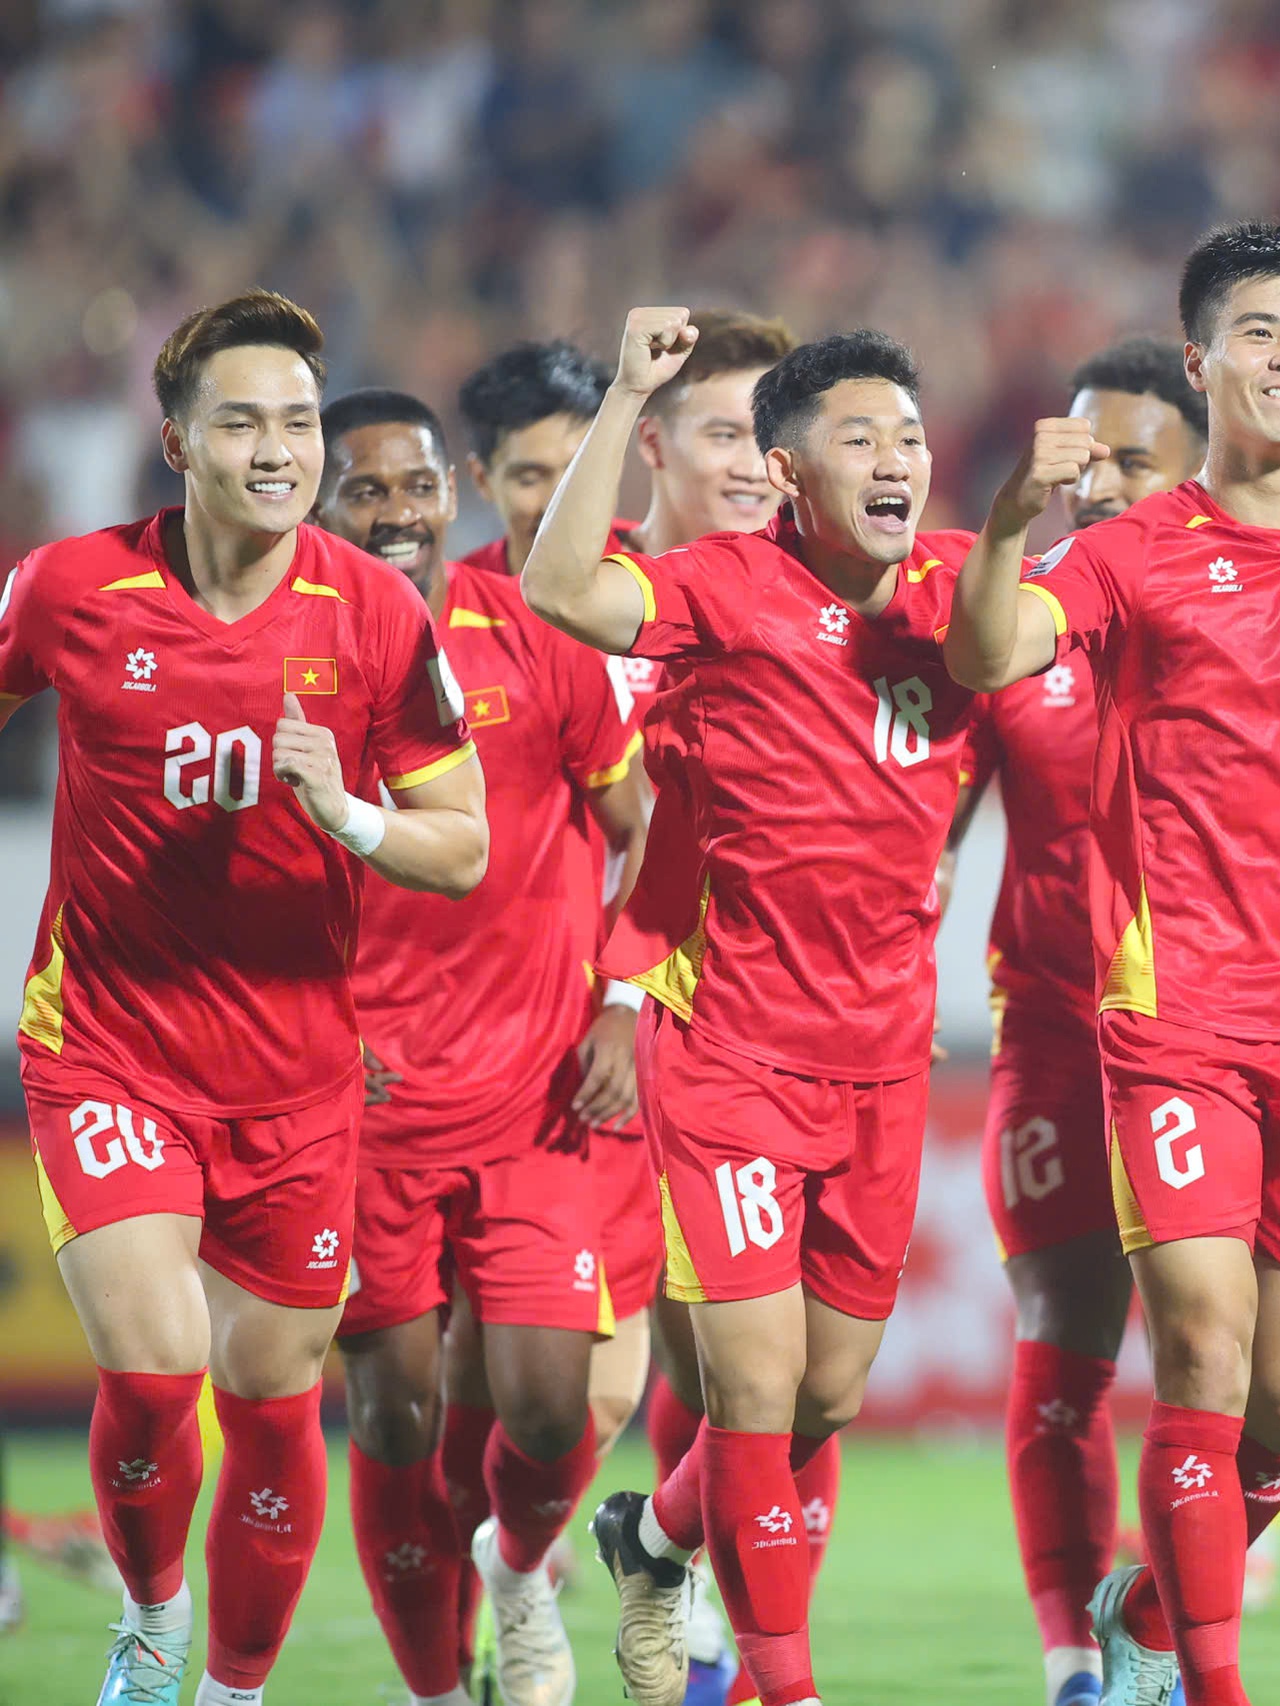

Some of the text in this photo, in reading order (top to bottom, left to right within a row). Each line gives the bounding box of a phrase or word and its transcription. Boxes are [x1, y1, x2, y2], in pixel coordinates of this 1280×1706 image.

[164, 721, 262, 812] 20
[873, 675, 933, 767] 18
[69, 1100, 166, 1179] 20
[1001, 1116, 1066, 1209] 12
[1150, 1096, 1205, 1190] 2
[714, 1156, 785, 1257] 18
